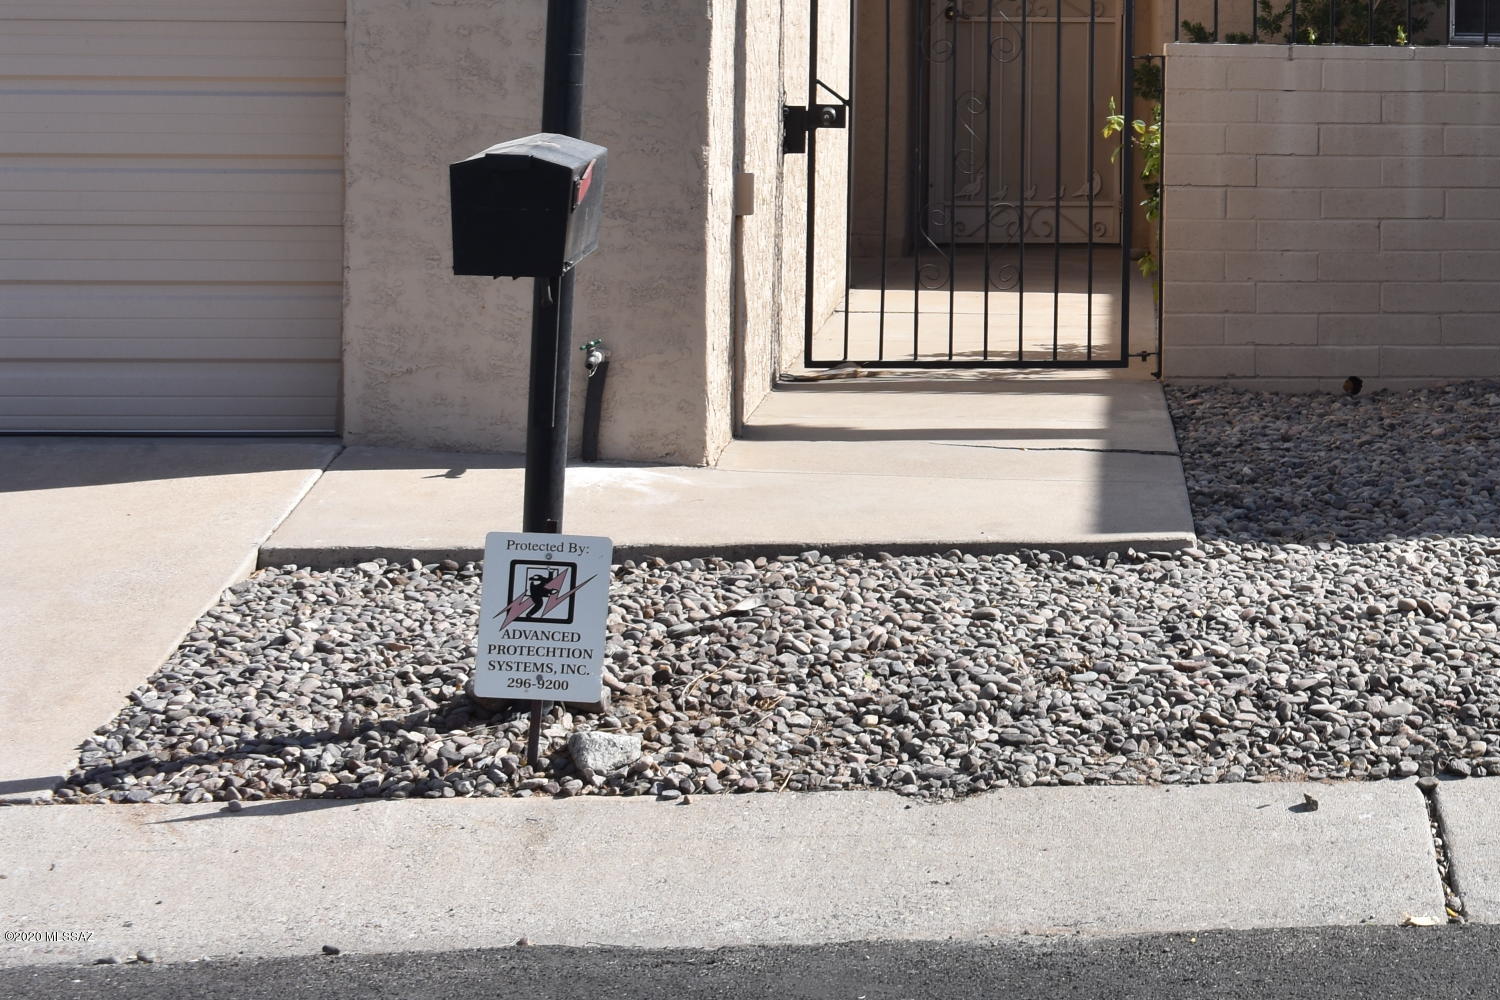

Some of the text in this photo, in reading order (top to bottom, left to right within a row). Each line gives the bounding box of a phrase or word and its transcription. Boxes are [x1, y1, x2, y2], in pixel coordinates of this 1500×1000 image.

[506, 539, 590, 556] Protected By:
[501, 628, 581, 643] ADVANCED
[487, 643, 594, 660] PROTECHTION
[487, 660, 590, 676] SYSTEMS, INC.
[507, 677, 569, 691] 296-9200
